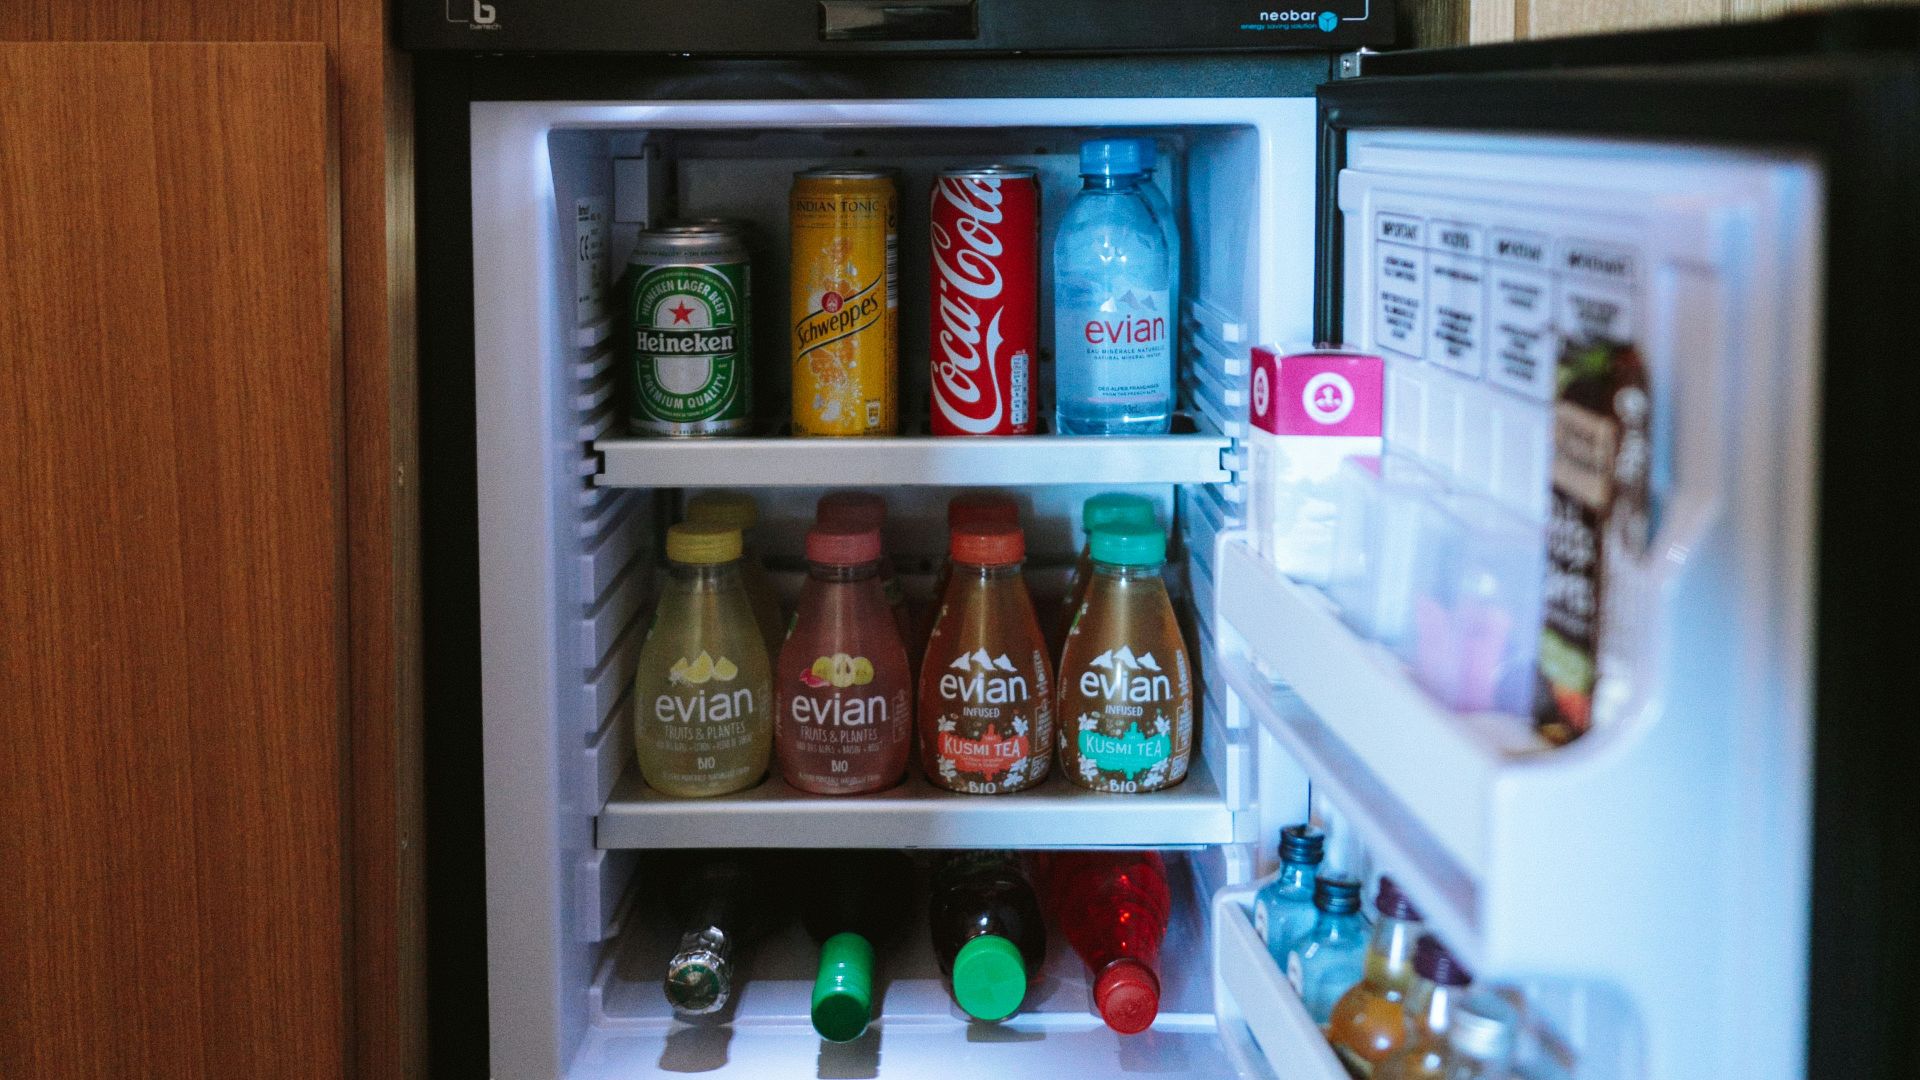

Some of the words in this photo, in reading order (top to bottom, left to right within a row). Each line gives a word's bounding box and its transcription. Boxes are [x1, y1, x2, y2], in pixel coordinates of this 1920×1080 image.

[1260, 10, 1316, 21] neobar
[841, 201, 880, 212] TONIC
[641, 280, 675, 316] HEINEKEN
[677, 279, 711, 296] LAGER
[708, 291, 726, 316] BEER
[930, 176, 1003, 434] Coca-Cola
[798, 292, 879, 350] Schweppes
[1085, 314, 1165, 344] evian
[637, 331, 734, 353] Heineken
[643, 374, 684, 409] PREMIUM
[687, 373, 727, 409] QUALITY
[940, 672, 1028, 704] evian
[1080, 670, 1172, 703] evian
[655, 688, 754, 723] evian
[791, 693, 887, 726] evian
[963, 707, 1000, 718] INFUSED
[1105, 704, 1144, 716] INFUSED
[695, 728, 705, 740] &
[707, 721, 746, 739] PLANTES
[800, 726, 828, 742] FRUITS
[829, 730, 838, 742] &
[840, 727, 878, 743] PLANTES
[944, 734, 989, 756] KUSMI
[994, 741, 1021, 757] TEA
[1085, 734, 1132, 755] KUSMI
[1136, 740, 1162, 757] TEA
[697, 756, 716, 769] BIO
[831, 760, 849, 772] BIO
[968, 781, 997, 793] BIO
[1109, 779, 1137, 793] BIO
